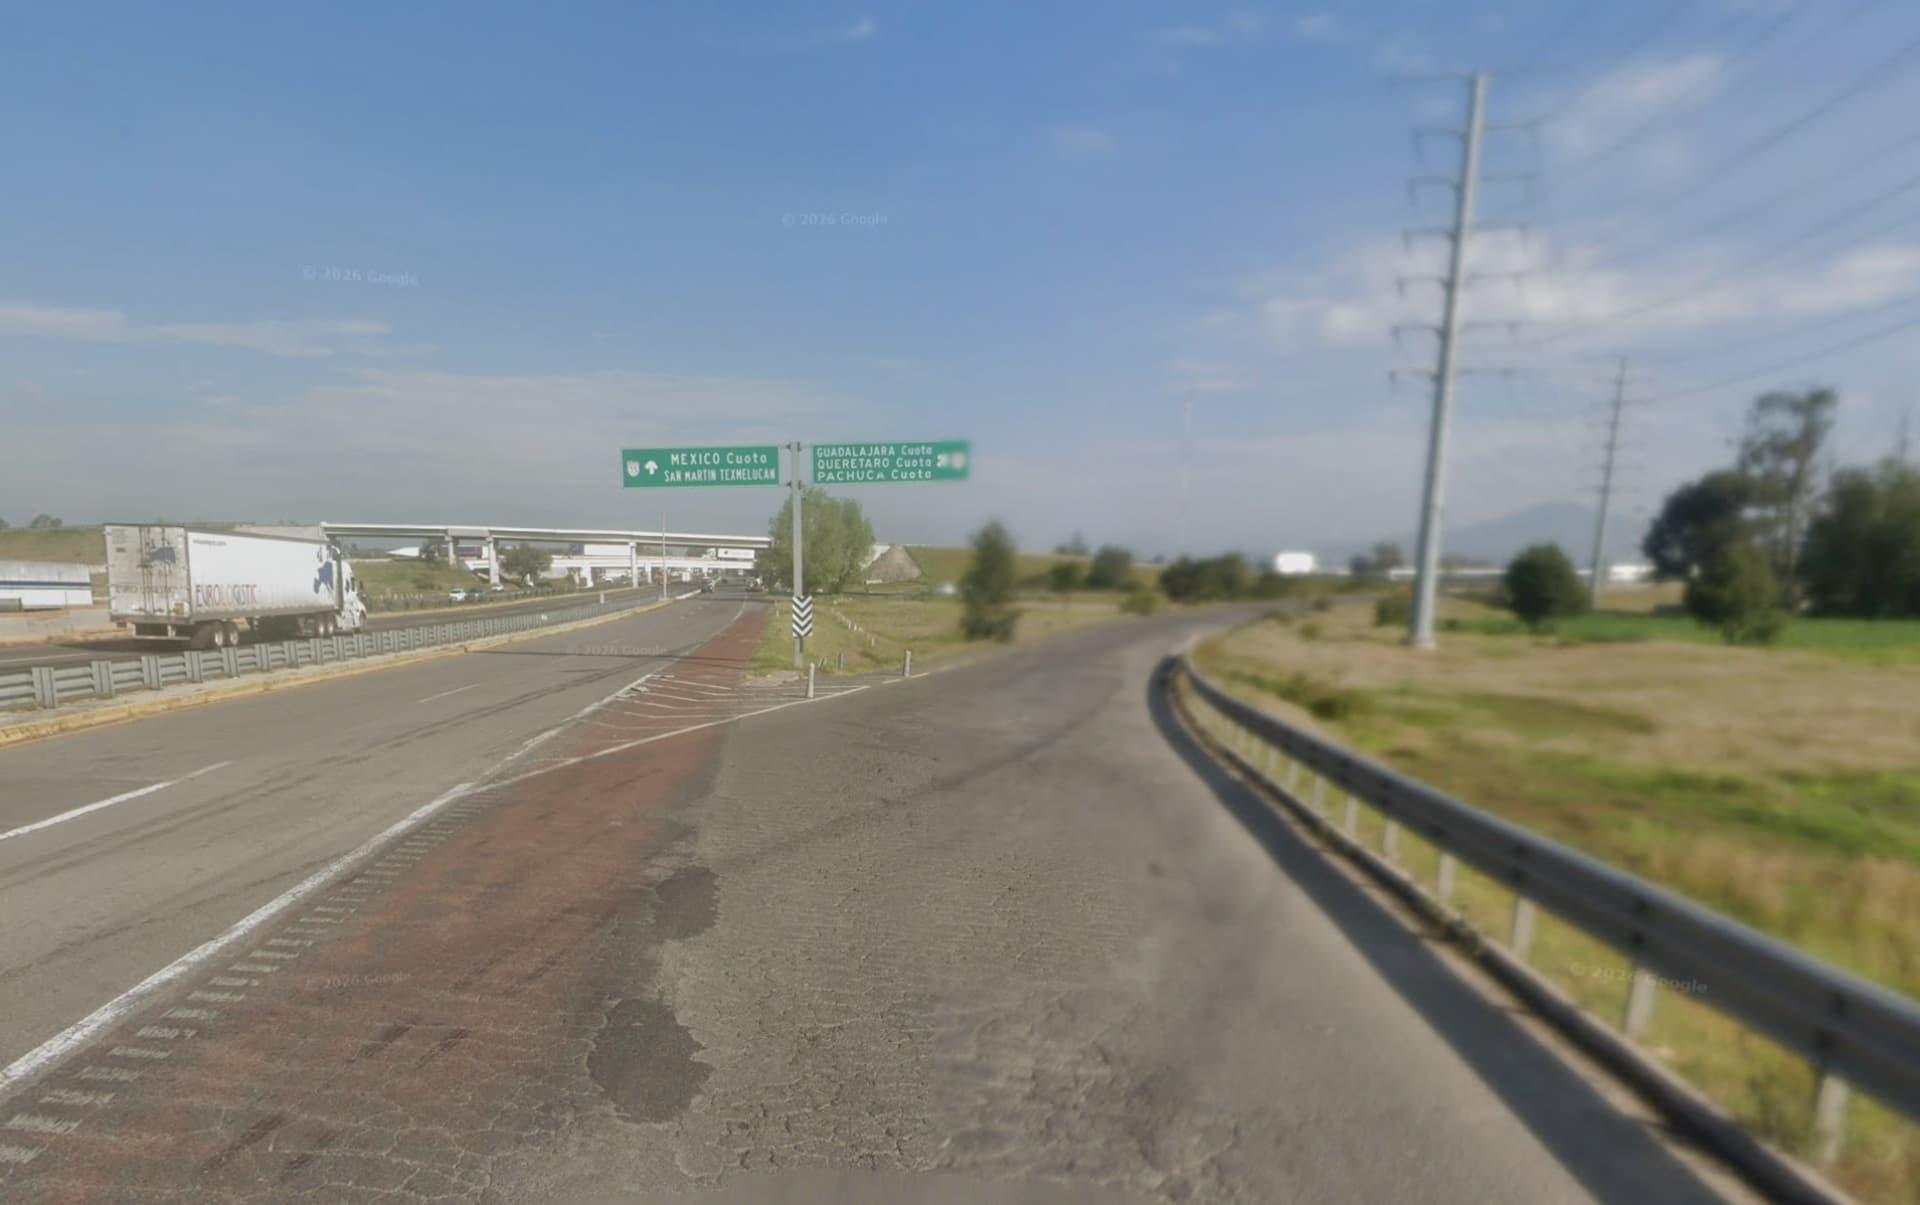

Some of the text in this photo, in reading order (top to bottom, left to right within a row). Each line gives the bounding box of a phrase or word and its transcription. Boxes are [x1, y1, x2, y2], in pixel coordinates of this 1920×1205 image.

[816, 445, 933, 458] GUADALAJARA Cuota
[671, 452, 767, 465] MEXICO Cuota
[817, 457, 932, 470] QUERETARO Cuota
[664, 468, 776, 482] SAN MARTIN TEXMELUCAN
[817, 469, 932, 481] PACHUCA Cuota
